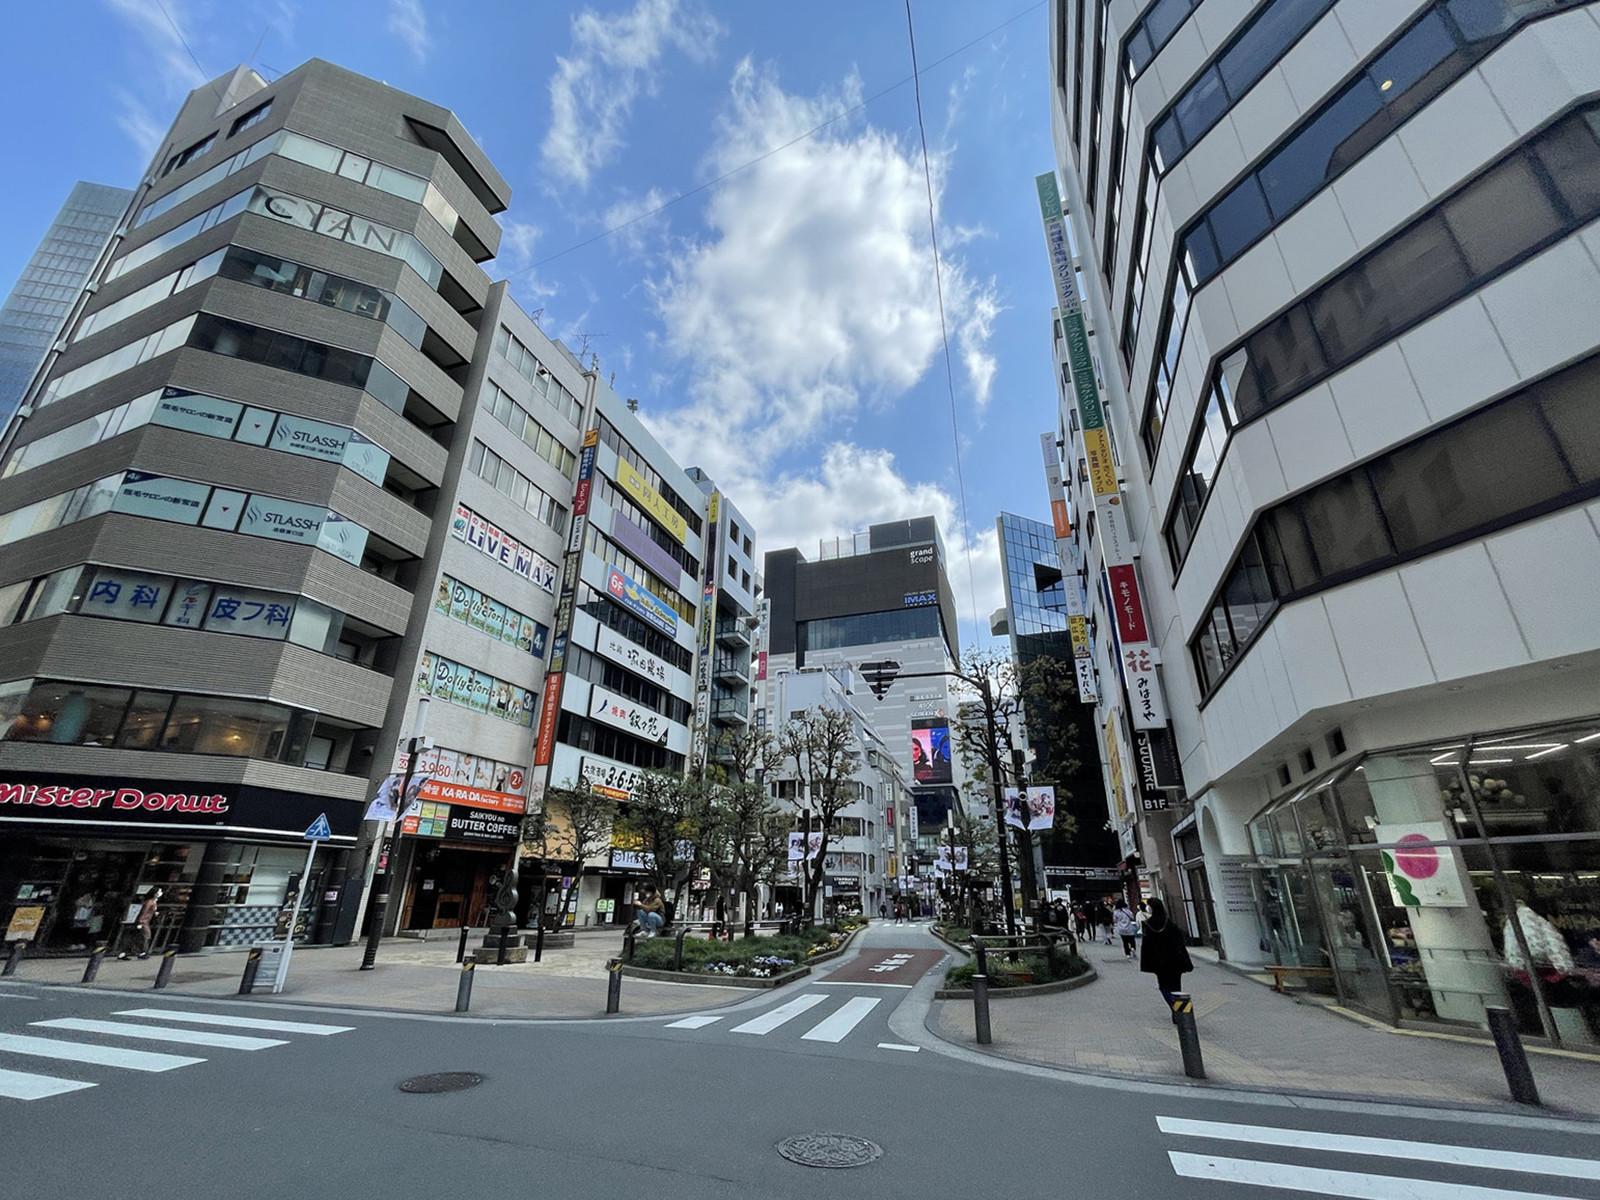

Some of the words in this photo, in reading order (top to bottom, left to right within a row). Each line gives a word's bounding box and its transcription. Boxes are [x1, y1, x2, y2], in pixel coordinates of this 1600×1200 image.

[264, 195, 396, 252] CYAN
[292, 430, 346, 450] STLASSH
[263, 512, 320, 531] STLASSH
[467, 525, 511, 563] LiVE
[516, 555, 554, 591] MAX
[910, 547, 933, 558] grand
[910, 555, 933, 564] scope
[610, 575, 623, 591] 6F
[89, 580, 161, 609] 内科
[904, 593, 936, 604] IMAX
[211, 596, 291, 627] 皮フ科
[1119, 581, 1136, 631] キモノモード
[1078, 617, 1086, 642] カラオケ
[1125, 649, 1152, 673] 花
[512, 773, 522, 786] 2F
[0, 783, 115, 809] Mister
[112, 787, 230, 814] Donut
[1144, 797, 1166, 811] B1F
[469, 810, 497, 821] SAIKYOU
[450, 818, 485, 832] BUTTER
[486, 822, 518, 835] COFFEE
